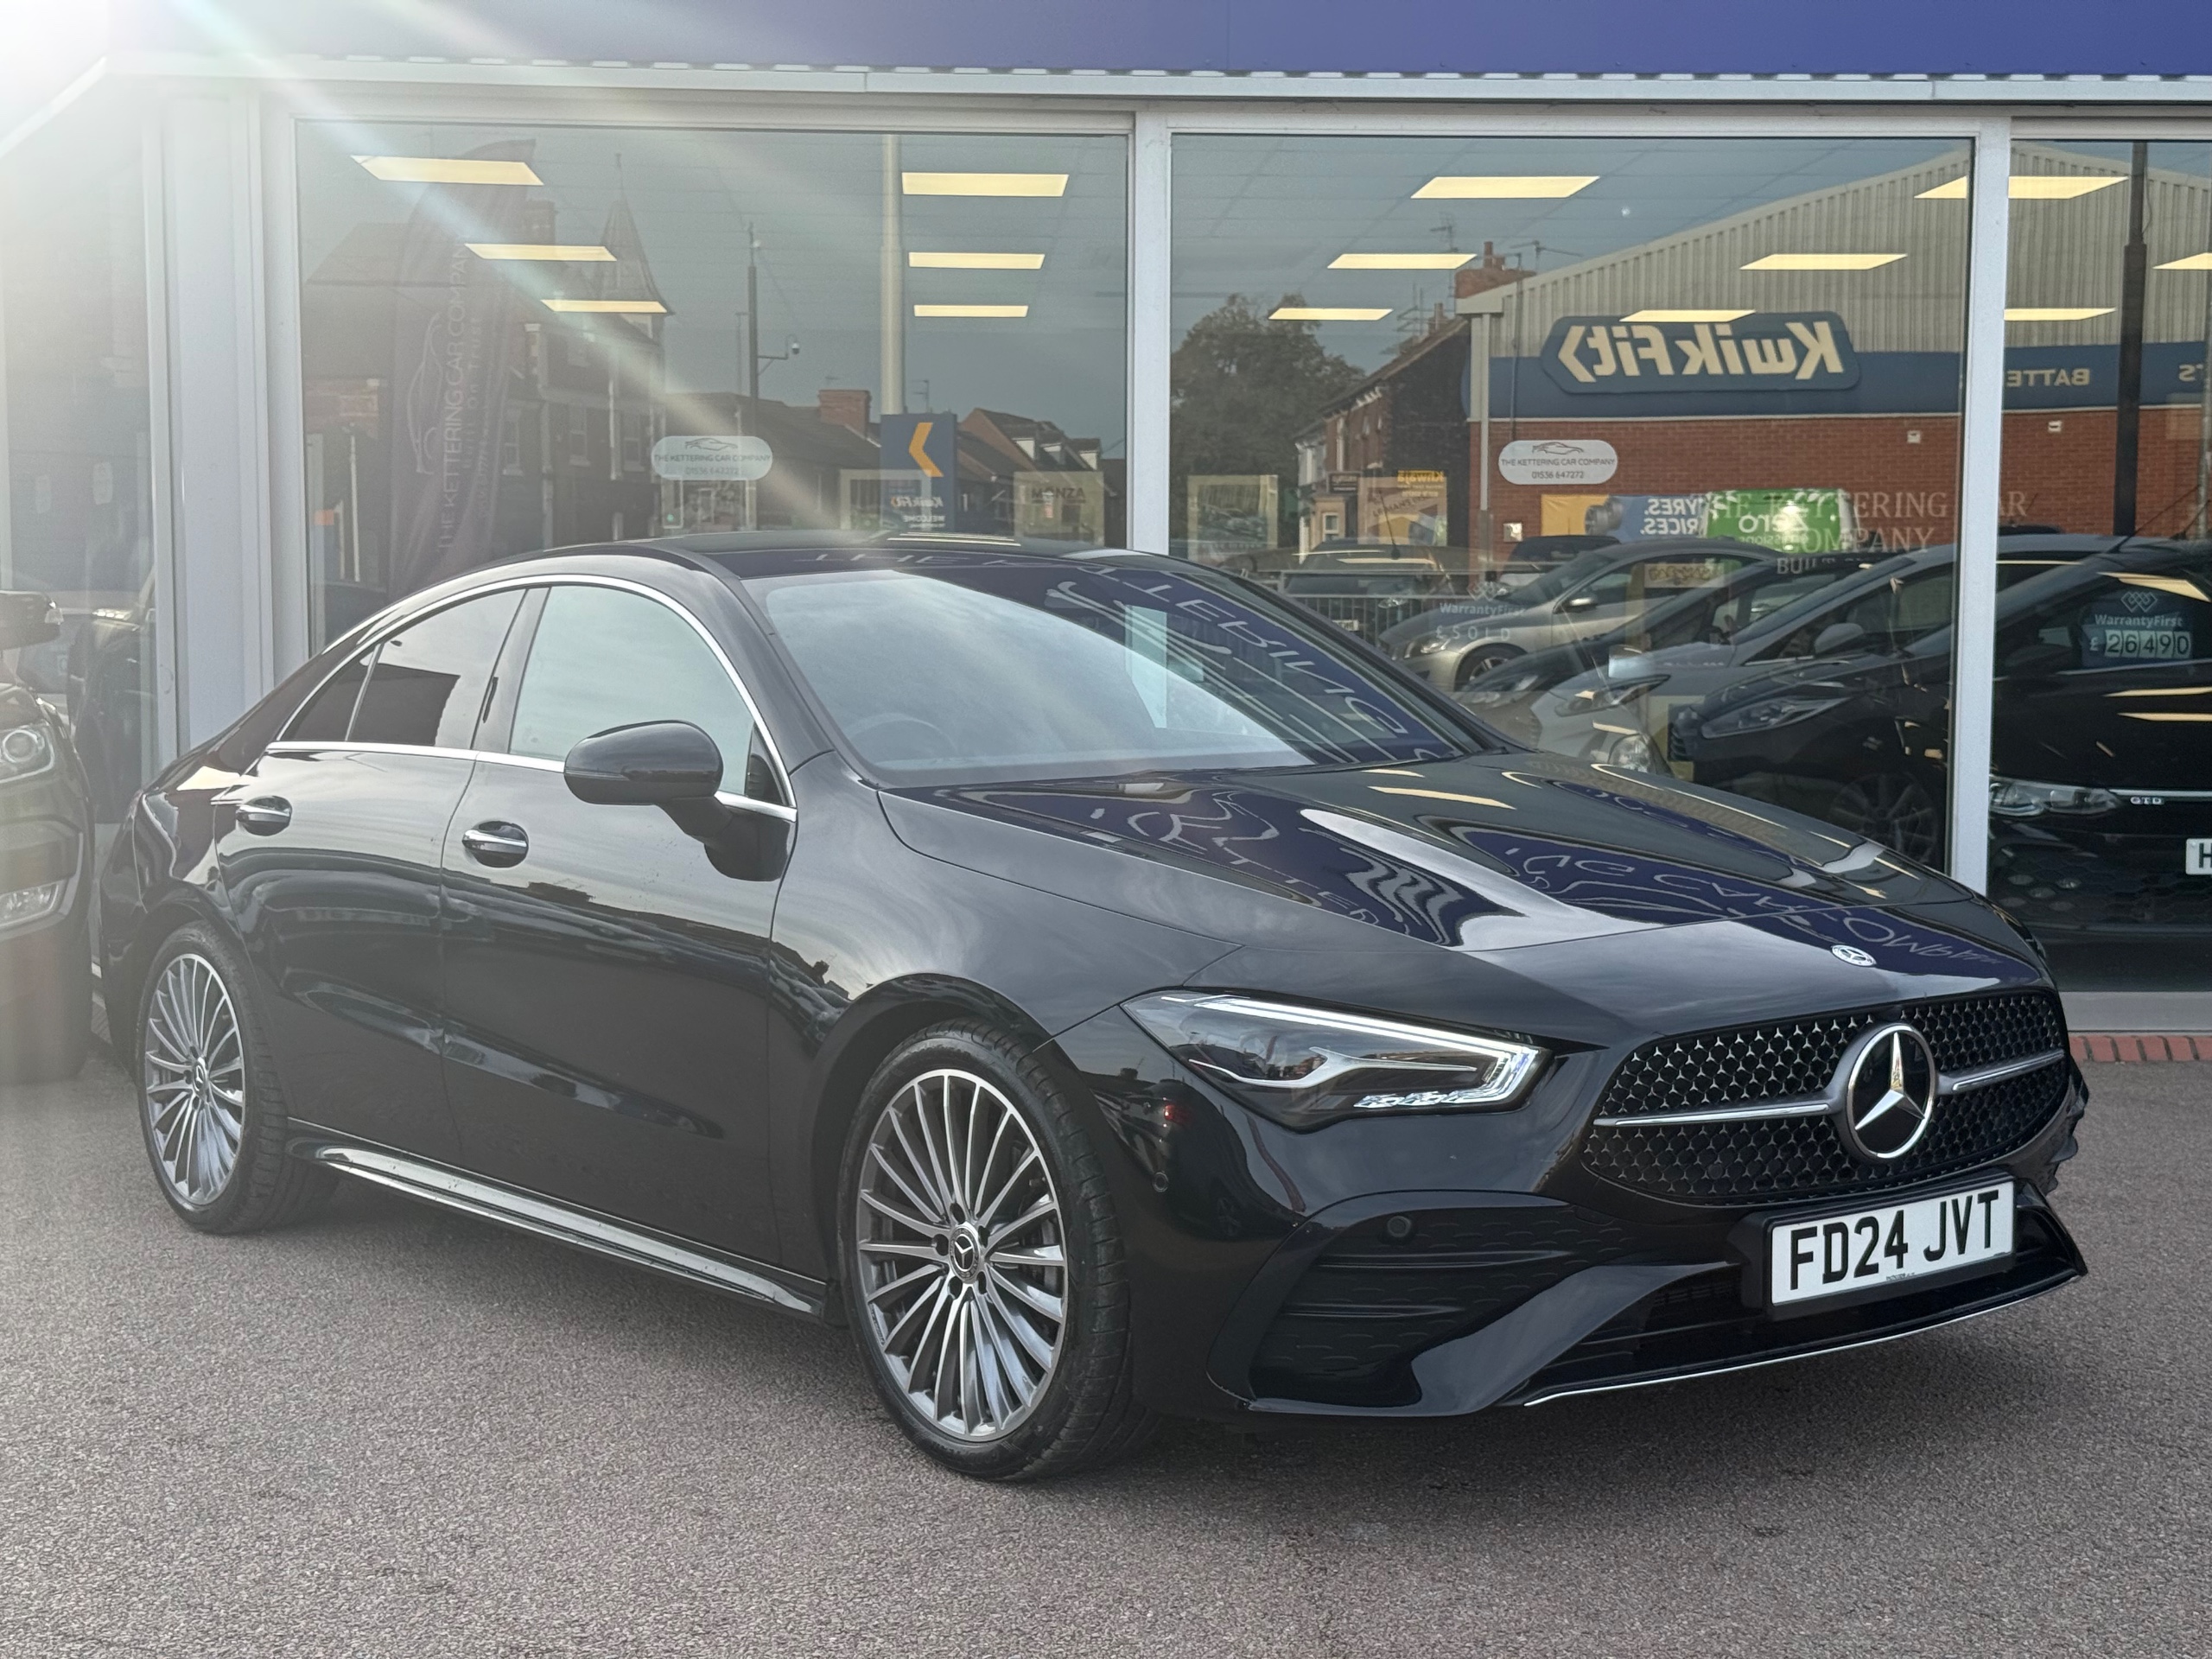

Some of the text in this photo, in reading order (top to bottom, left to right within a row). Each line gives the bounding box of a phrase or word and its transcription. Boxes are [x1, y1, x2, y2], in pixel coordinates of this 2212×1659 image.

[444, 342, 465, 386] CAR
[442, 391, 464, 508] KETTERING
[1501, 458, 1616, 467] THE KETTERING CAR COMPANY
[2094, 613, 2183, 628] WarrantyFirst
[2130, 796, 2162, 805] GTD
[1789, 1189, 1999, 1291] FD24 JVT
